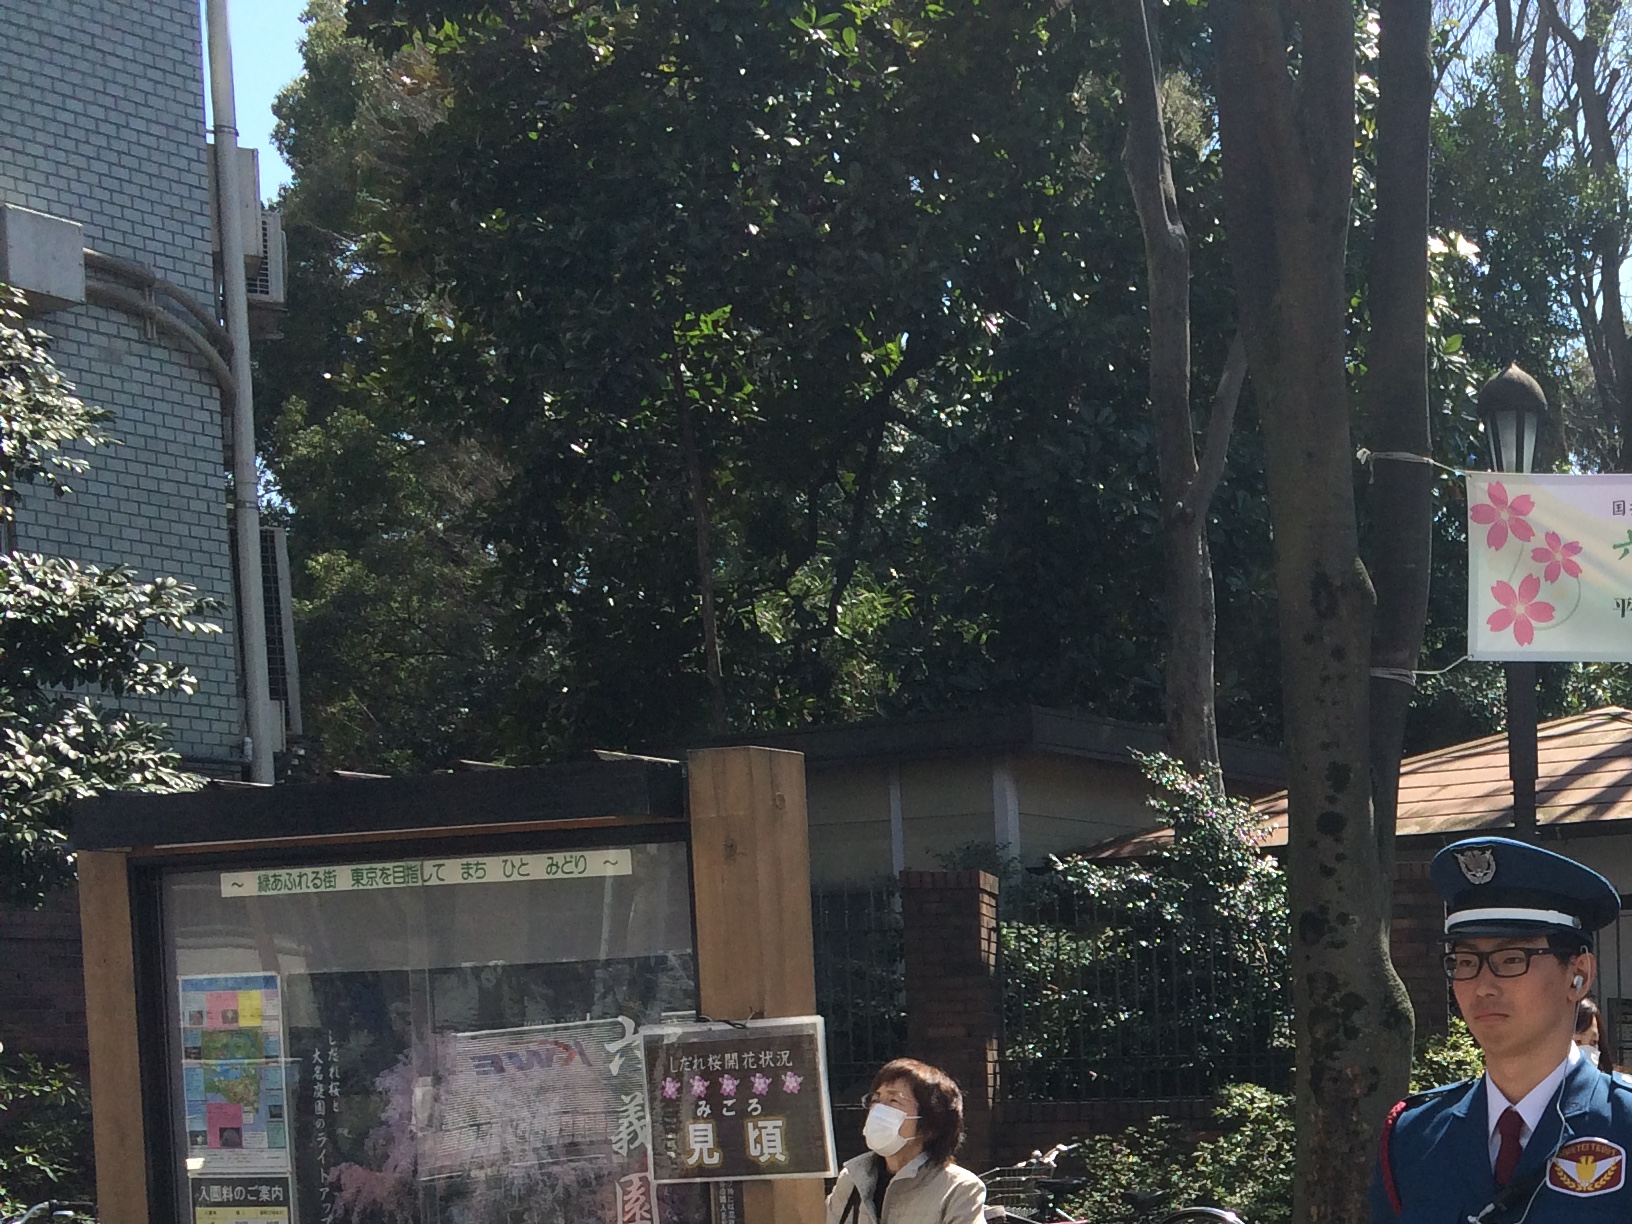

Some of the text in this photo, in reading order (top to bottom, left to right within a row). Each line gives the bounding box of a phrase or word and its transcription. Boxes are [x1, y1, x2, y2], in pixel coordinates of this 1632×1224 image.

[257, 869, 337, 893] 緑あふれる街
[350, 863, 446, 887] 東京を目指して
[460, 860, 487, 880] まち
[502, 858, 531, 878] ひと
[545, 854, 587, 875] みどり
[669, 1050, 793, 1073] しだれ桜開花状況
[687, 1120, 786, 1165] 見頃
[198, 1184, 284, 1202] 入園料のご案内
